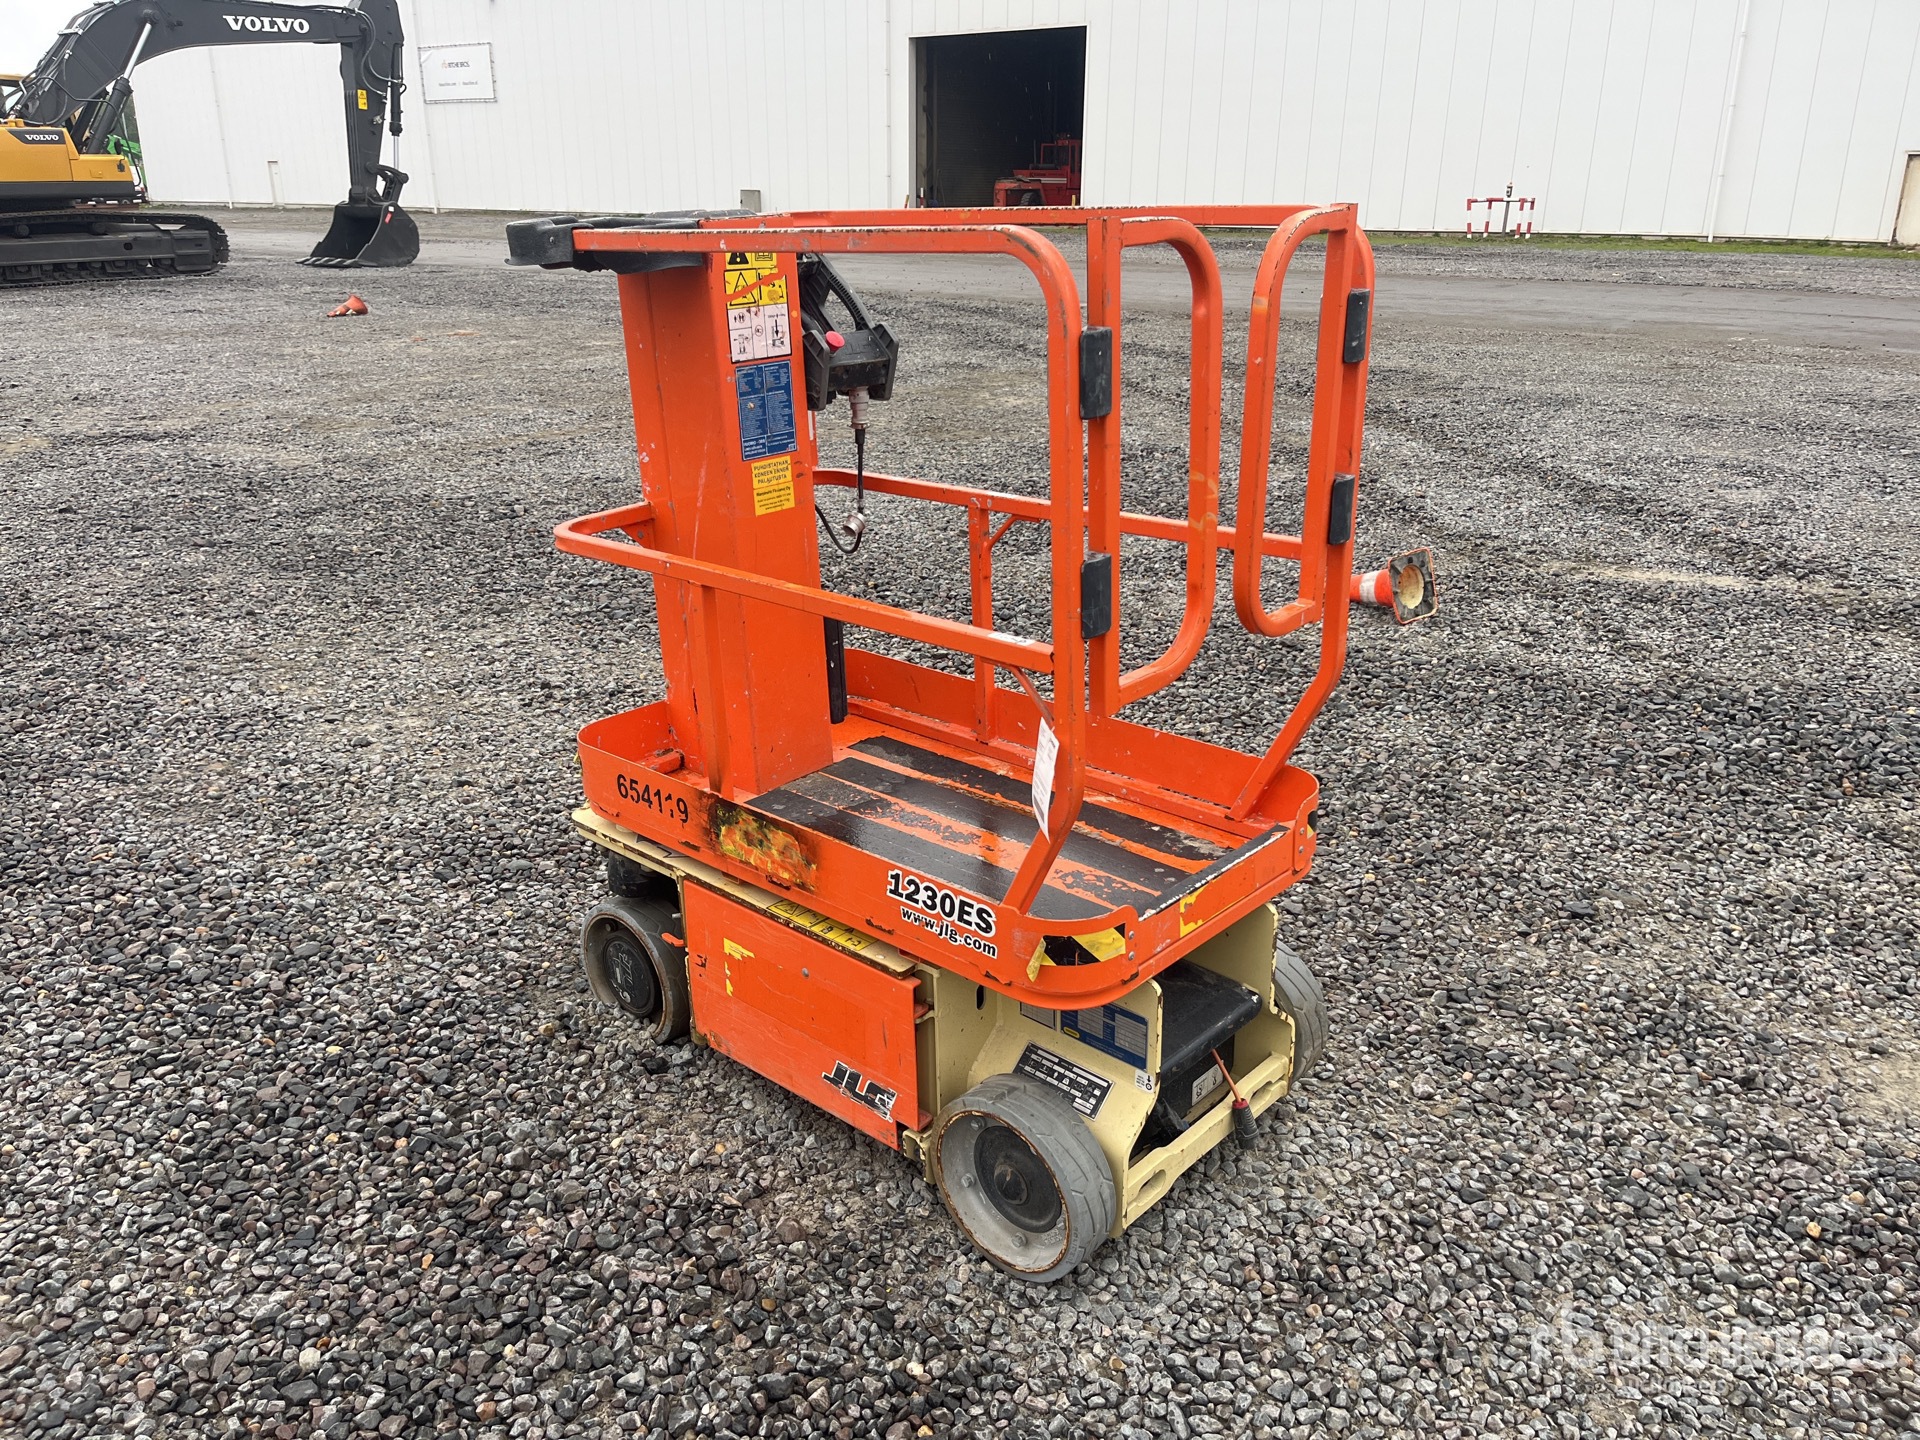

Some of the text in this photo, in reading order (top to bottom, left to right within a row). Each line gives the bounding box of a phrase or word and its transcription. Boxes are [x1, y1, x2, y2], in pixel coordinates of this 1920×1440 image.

[223, 15, 310, 34] VOLVO
[887, 870, 996, 936] 1230ES
[900, 905, 998, 958] www.jlg.com
[822, 1060, 897, 1122] JLG
